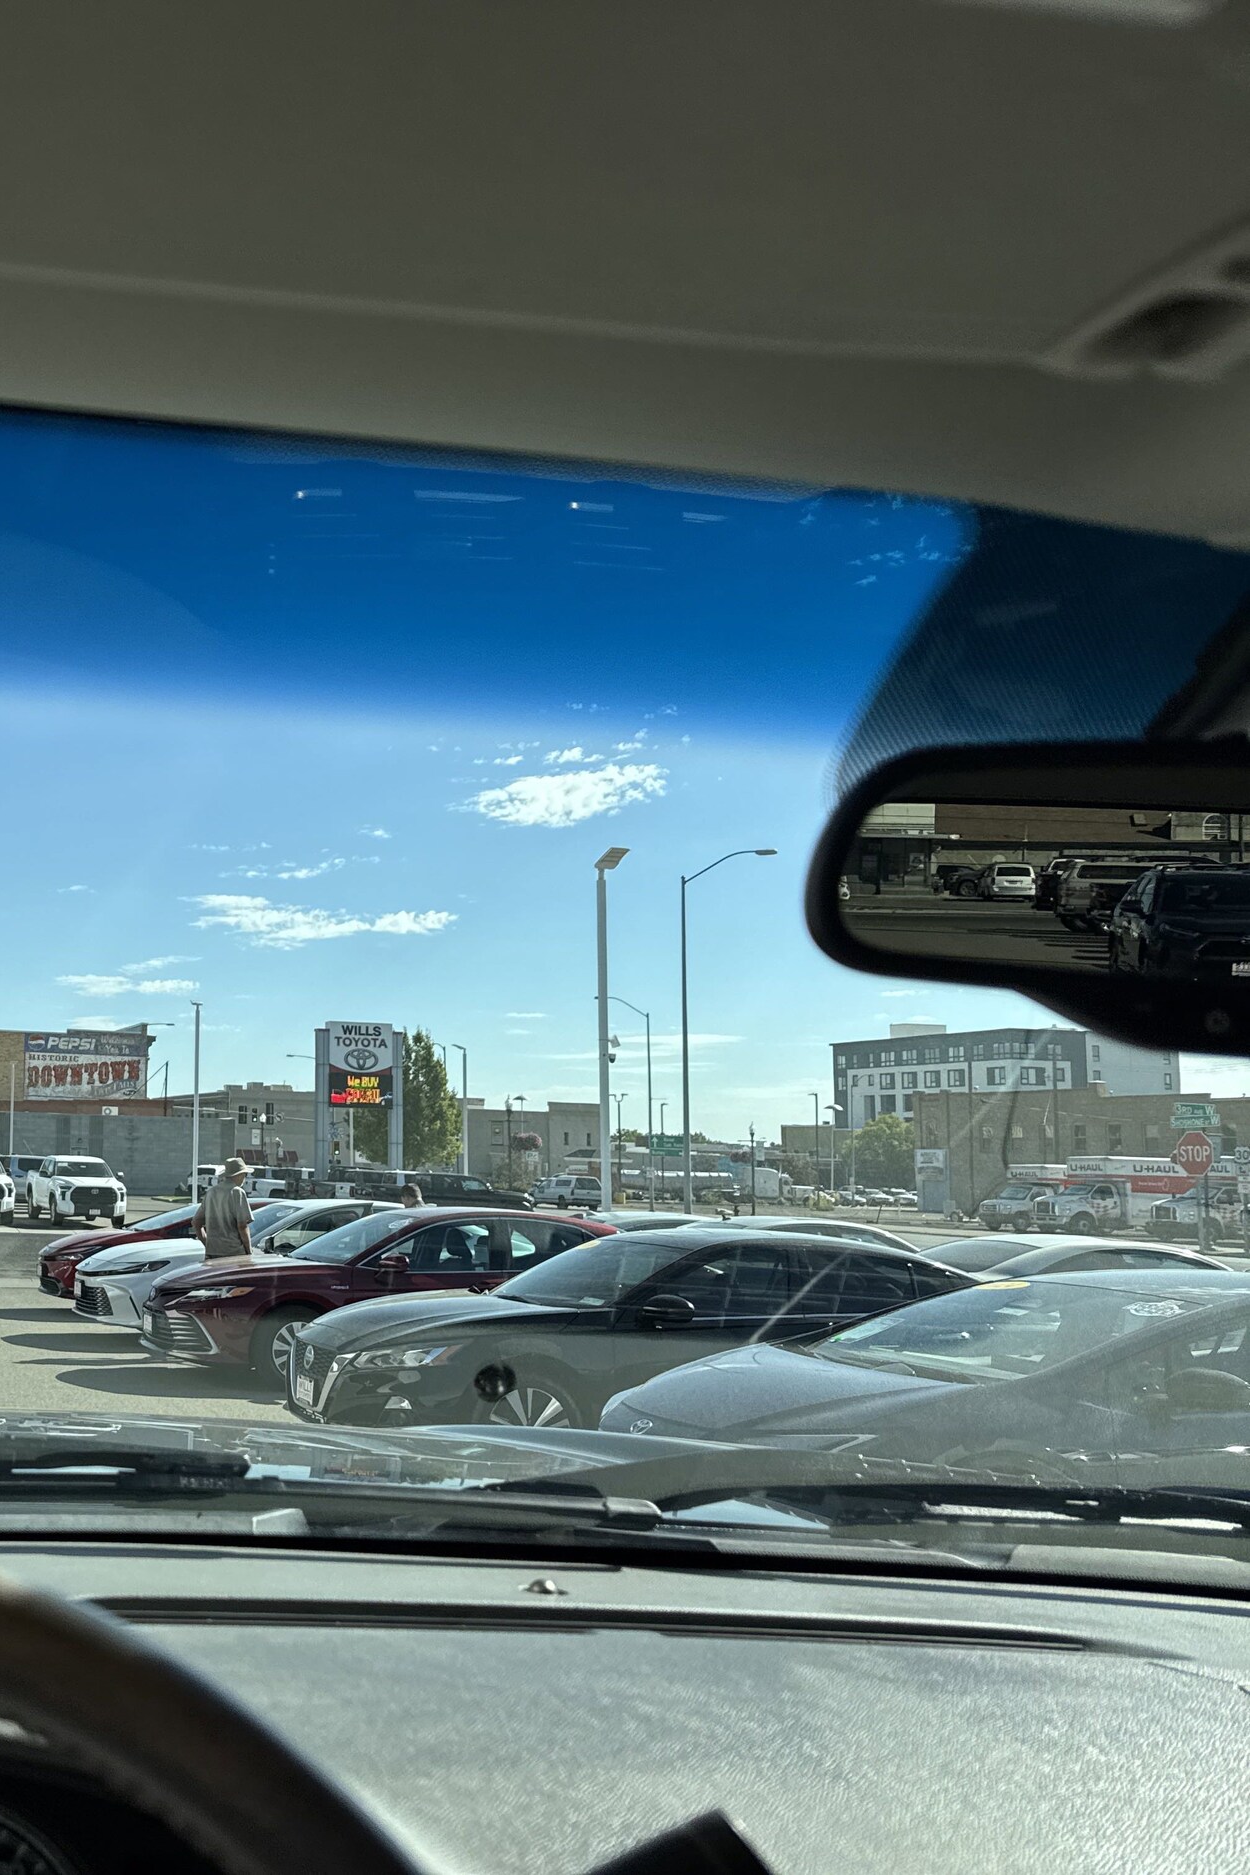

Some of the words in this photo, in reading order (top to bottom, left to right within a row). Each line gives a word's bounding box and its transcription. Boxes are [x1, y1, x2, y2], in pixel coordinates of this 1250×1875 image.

[342, 1025, 382, 1036] WILLS
[47, 1037, 96, 1051] PEPSI
[334, 1036, 388, 1048] TOYOTA
[28, 1054, 79, 1062] HISTORIC
[28, 1060, 140, 1088] DOWNTOWN
[1175, 1105, 1192, 1115] 3RD
[1204, 1105, 1214, 1116] W
[1210, 1115, 1220, 1125] W
[1179, 1145, 1210, 1162] STOP
[1235, 1150, 1249, 1160] 30
[1070, 1163, 1103, 1172] U-HAUL
[1133, 1164, 1179, 1174] U-HAUL
[1210, 1165, 1230, 1174] AUL
